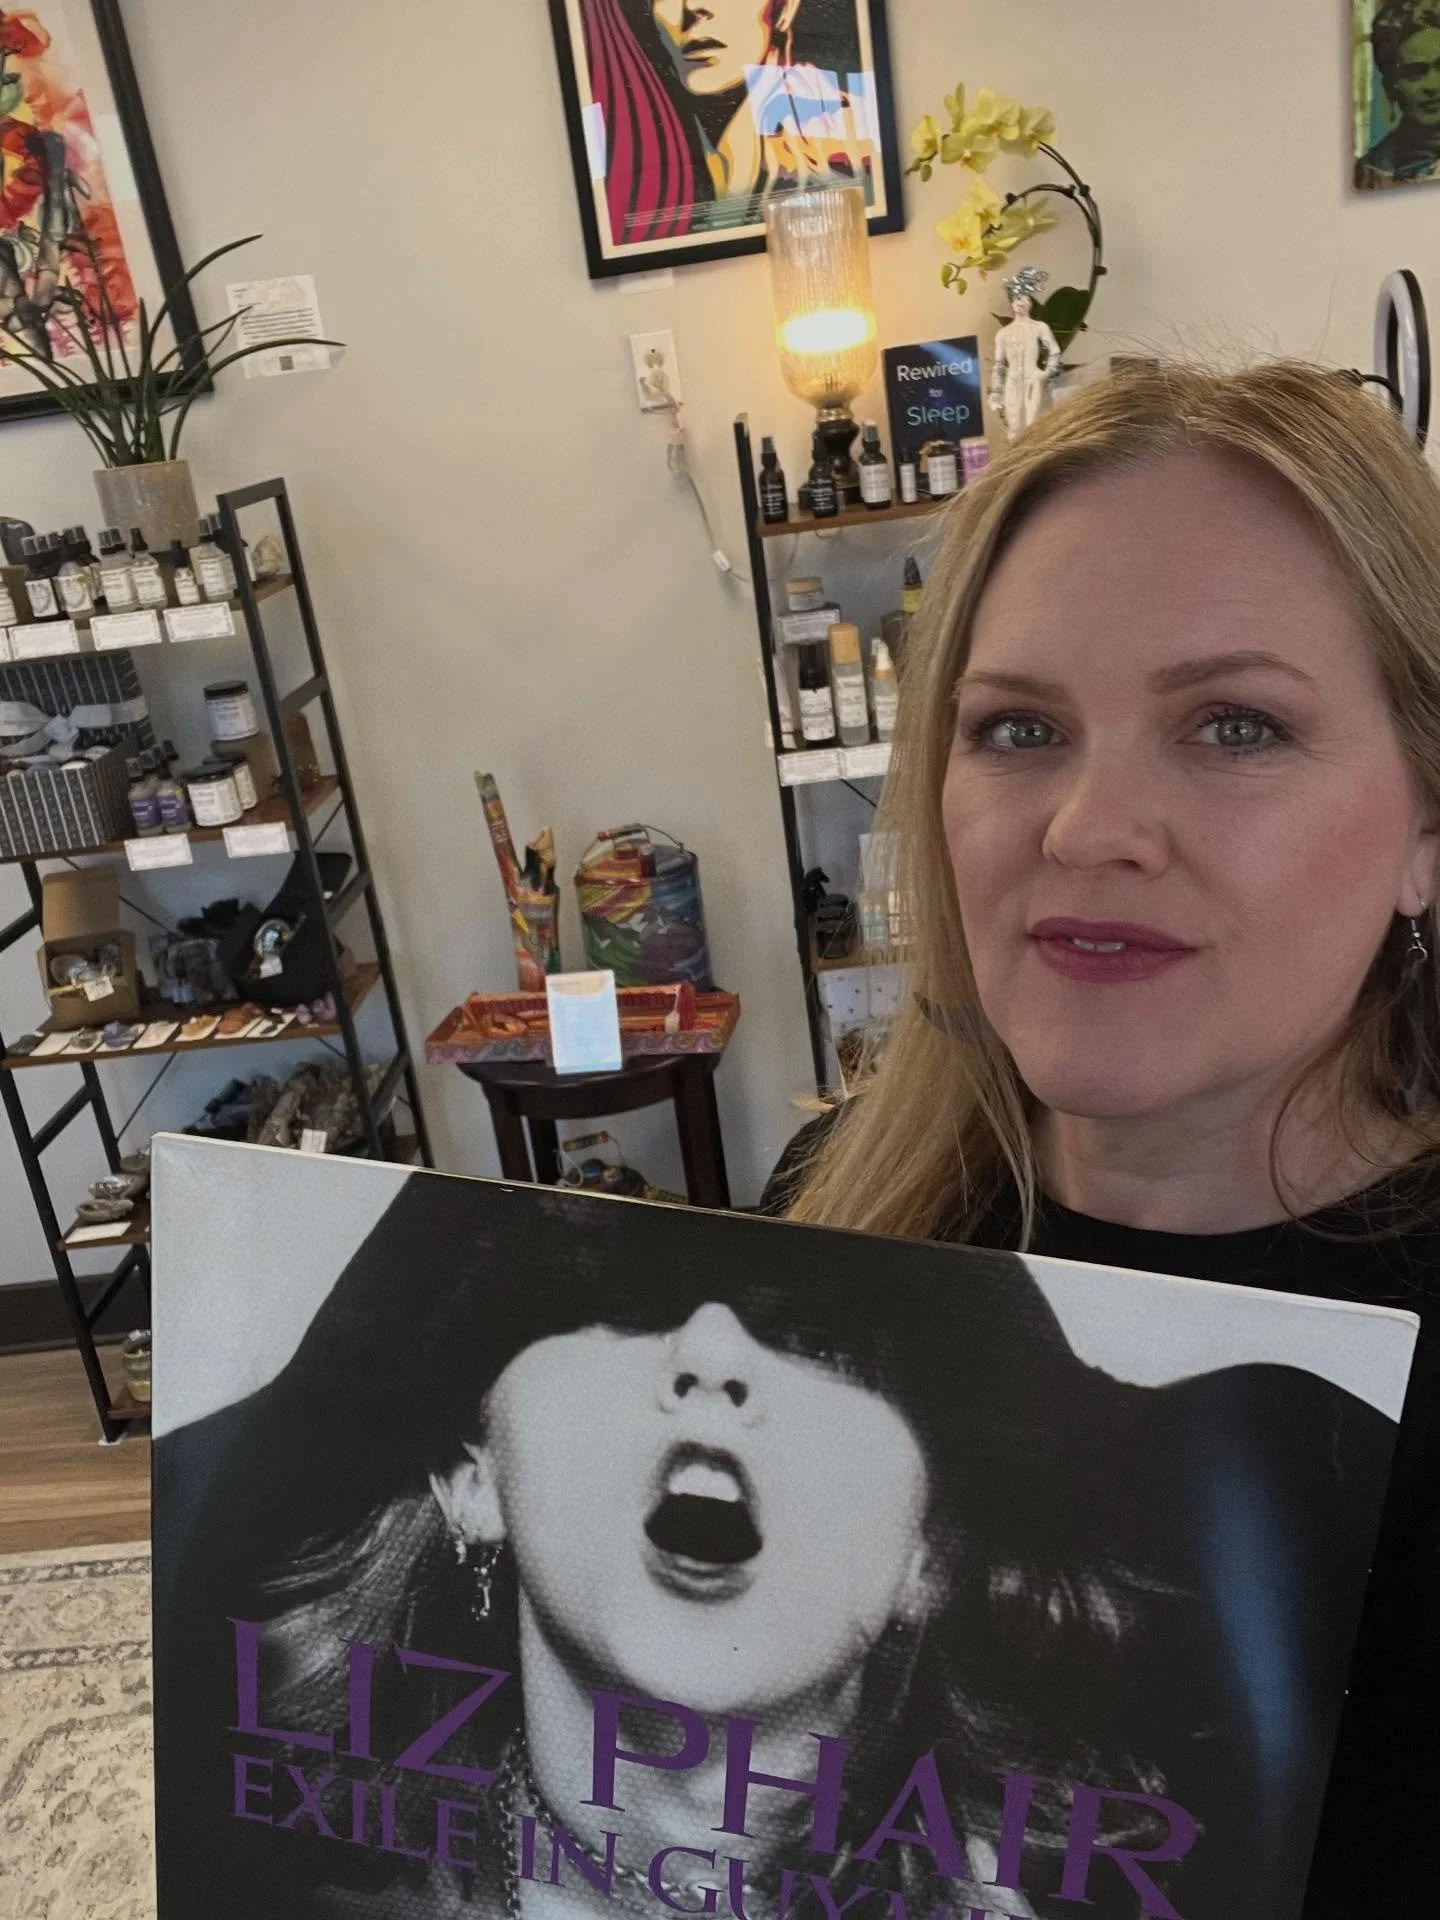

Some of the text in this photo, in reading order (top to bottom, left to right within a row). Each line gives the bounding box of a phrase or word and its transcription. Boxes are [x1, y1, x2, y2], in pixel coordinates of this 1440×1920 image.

[896, 356, 973, 382] Rewired
[906, 404, 970, 426] Sleep
[227, 1617, 1197, 1920] LIZ PHAIR
[231, 1754, 478, 1869] EXILE
[515, 1814, 623, 1898] IN
